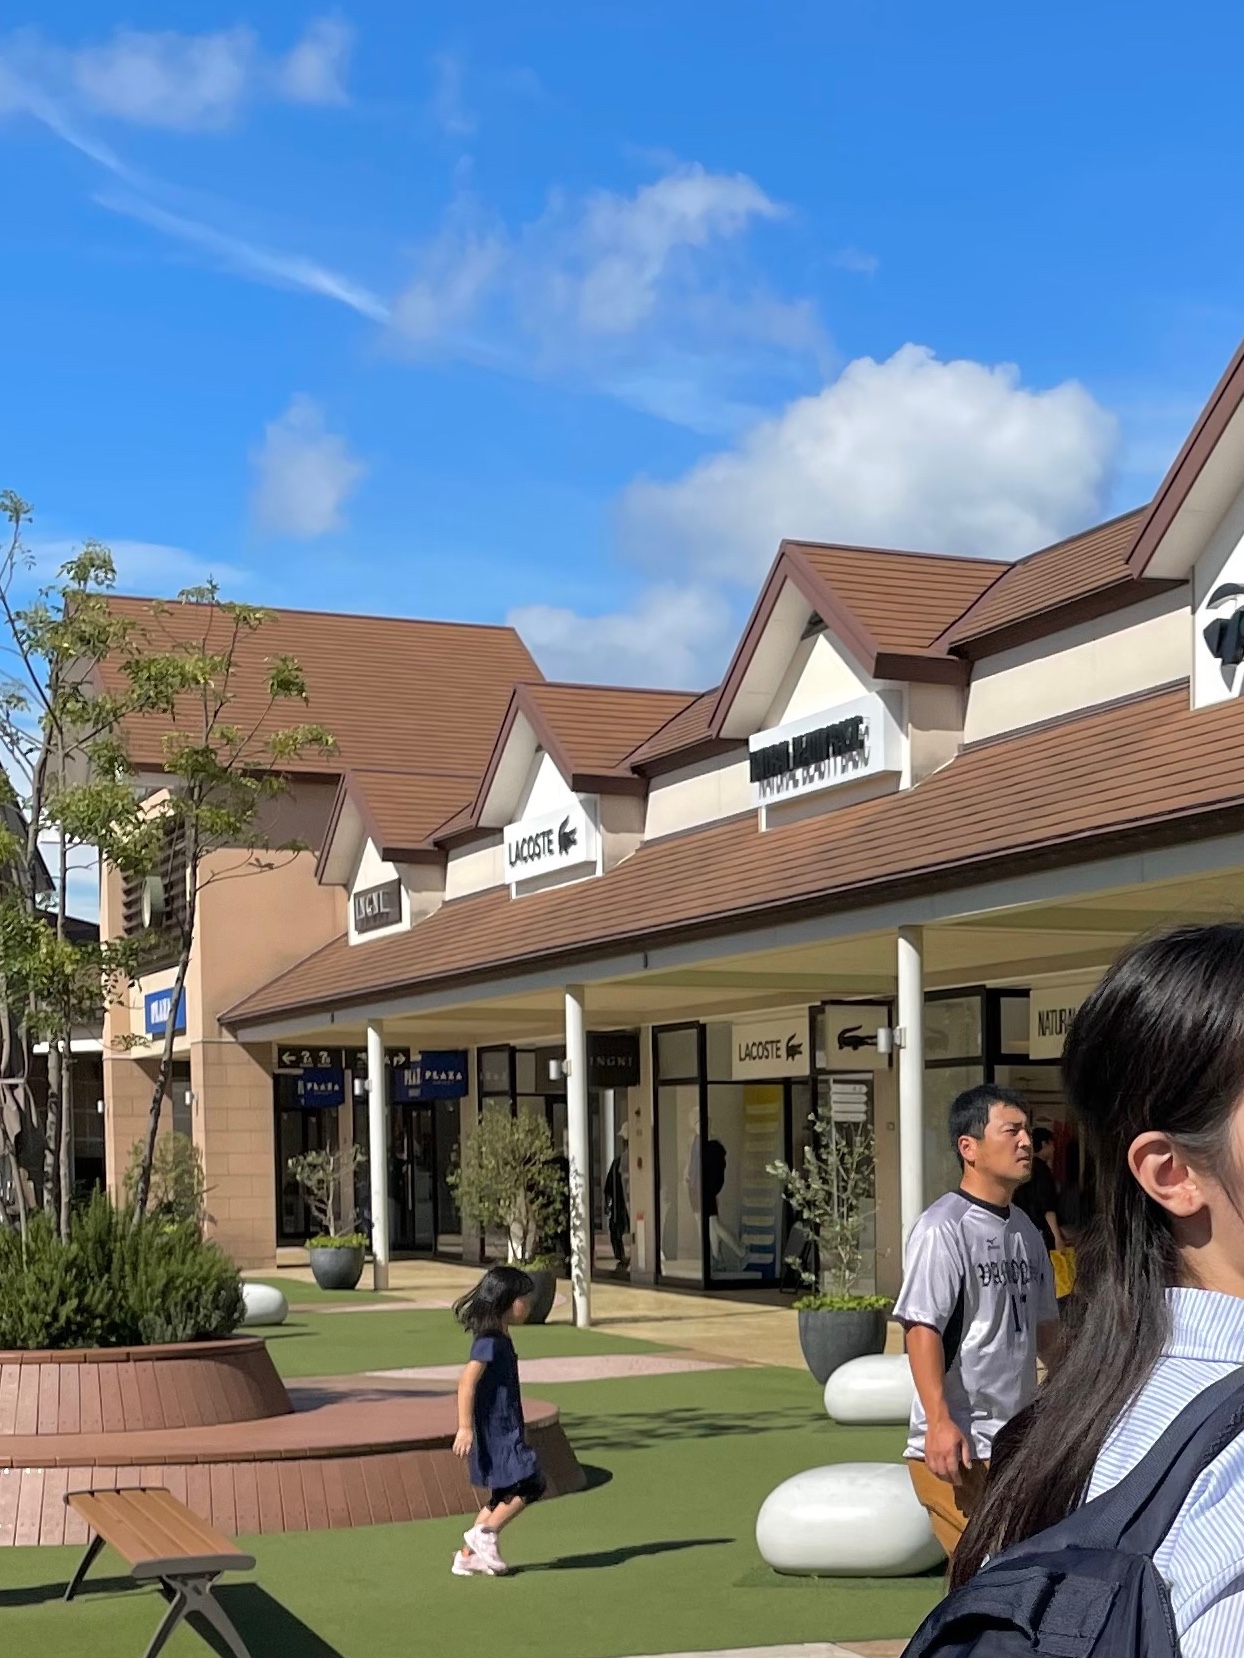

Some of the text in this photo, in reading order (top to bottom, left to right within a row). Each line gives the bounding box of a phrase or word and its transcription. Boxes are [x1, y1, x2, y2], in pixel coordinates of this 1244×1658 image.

[508, 829, 554, 867] LACOSTE
[739, 1039, 782, 1062] LACOSTE
[424, 1070, 463, 1081] PLAZA
[306, 1082, 340, 1092] PLAZA
